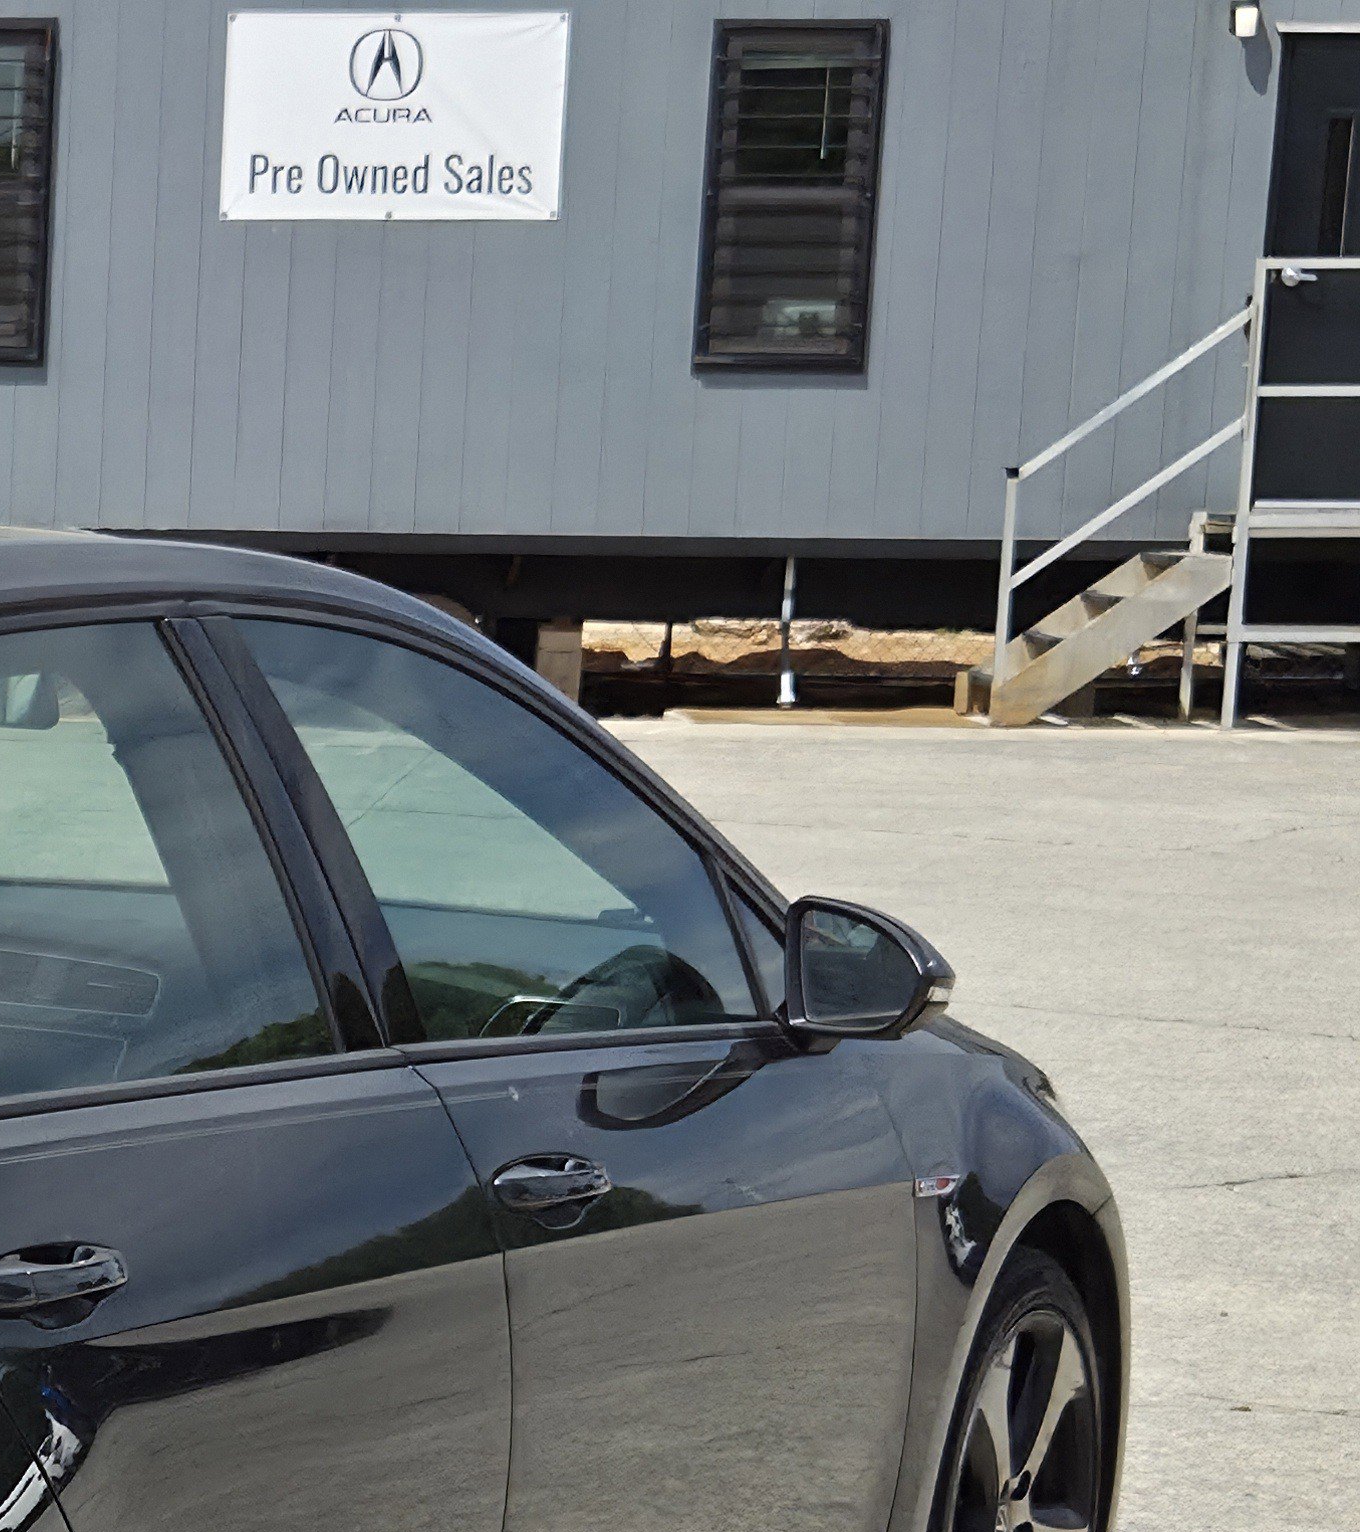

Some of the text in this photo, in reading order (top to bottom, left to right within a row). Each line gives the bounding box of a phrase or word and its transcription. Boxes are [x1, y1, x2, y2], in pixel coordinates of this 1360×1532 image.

[334, 108, 433, 124] ACURA
[249, 154, 533, 194] Pre Owned Sales
